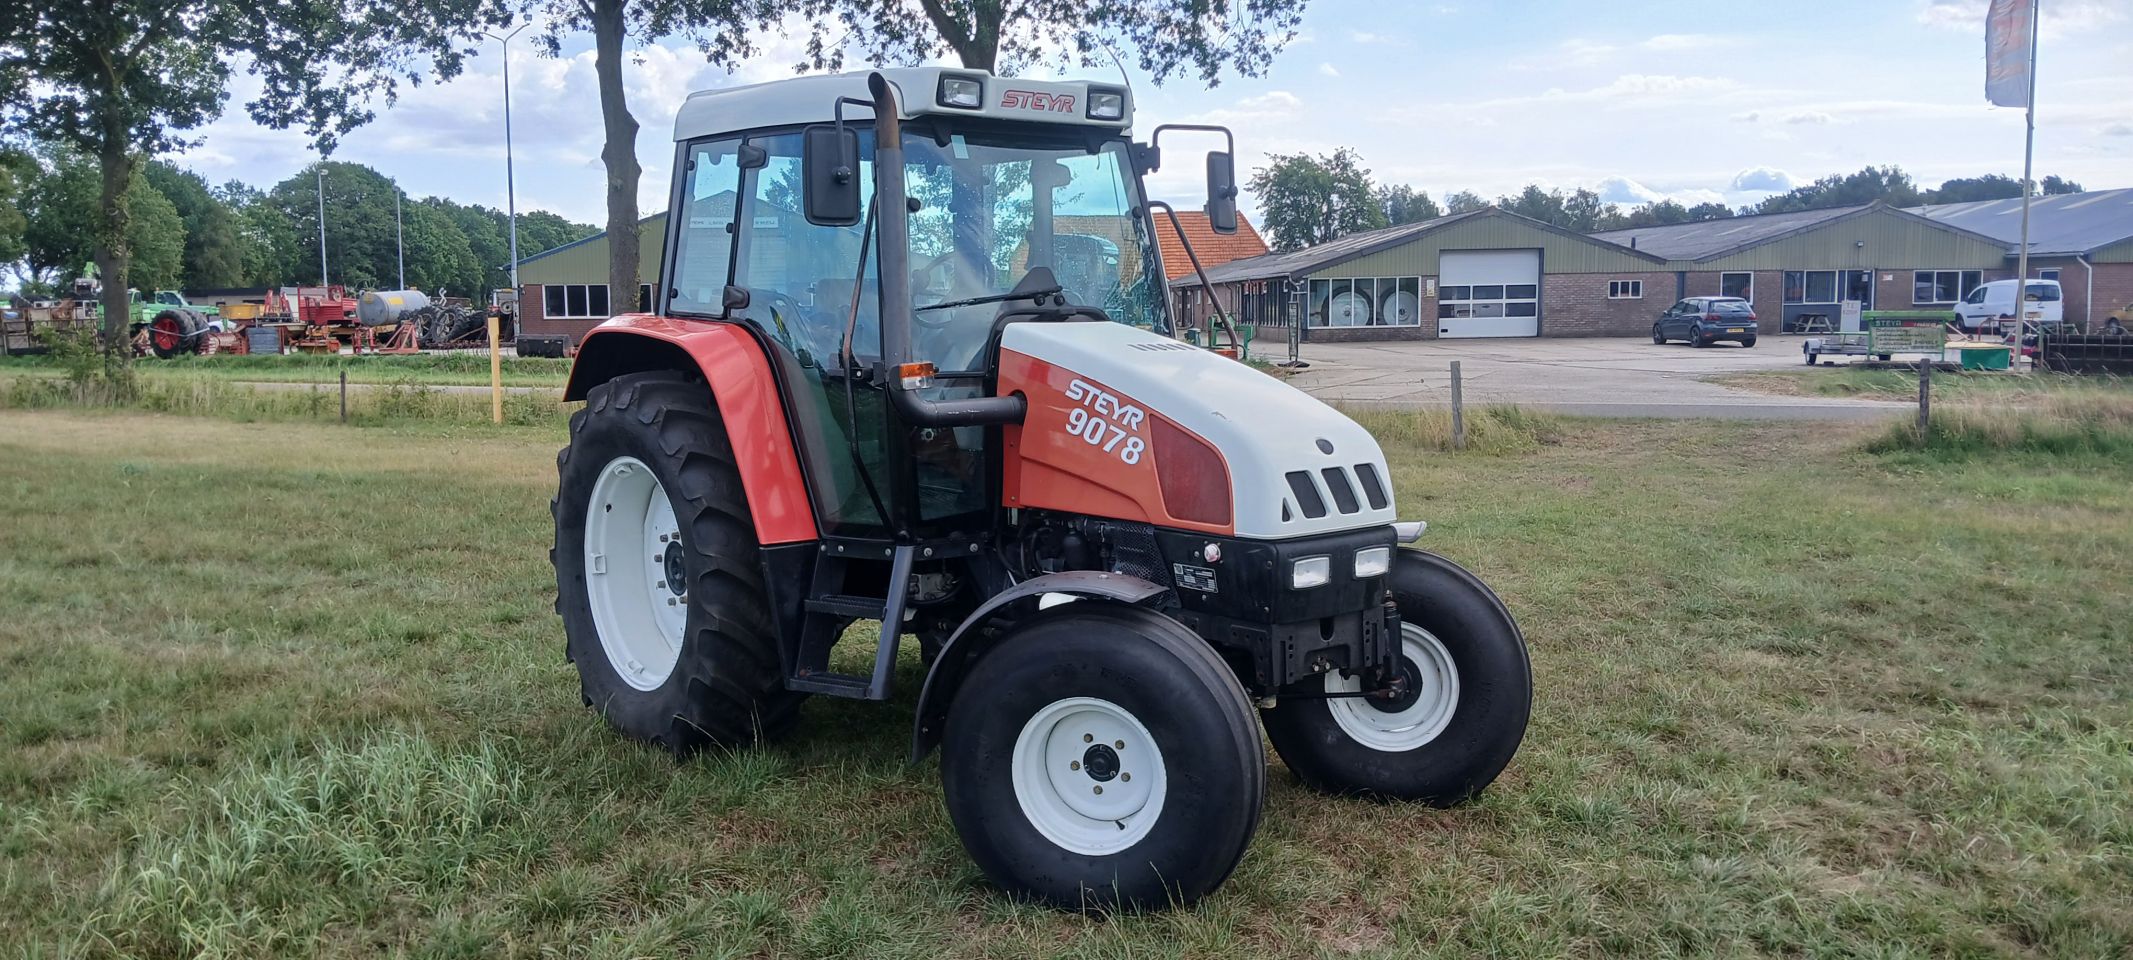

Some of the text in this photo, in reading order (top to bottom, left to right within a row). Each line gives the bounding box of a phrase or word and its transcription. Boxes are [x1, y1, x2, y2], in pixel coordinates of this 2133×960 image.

[1001, 90, 1075, 113] STEYR
[1065, 379, 1145, 432] STEYR
[1065, 408, 1145, 465] 9078
